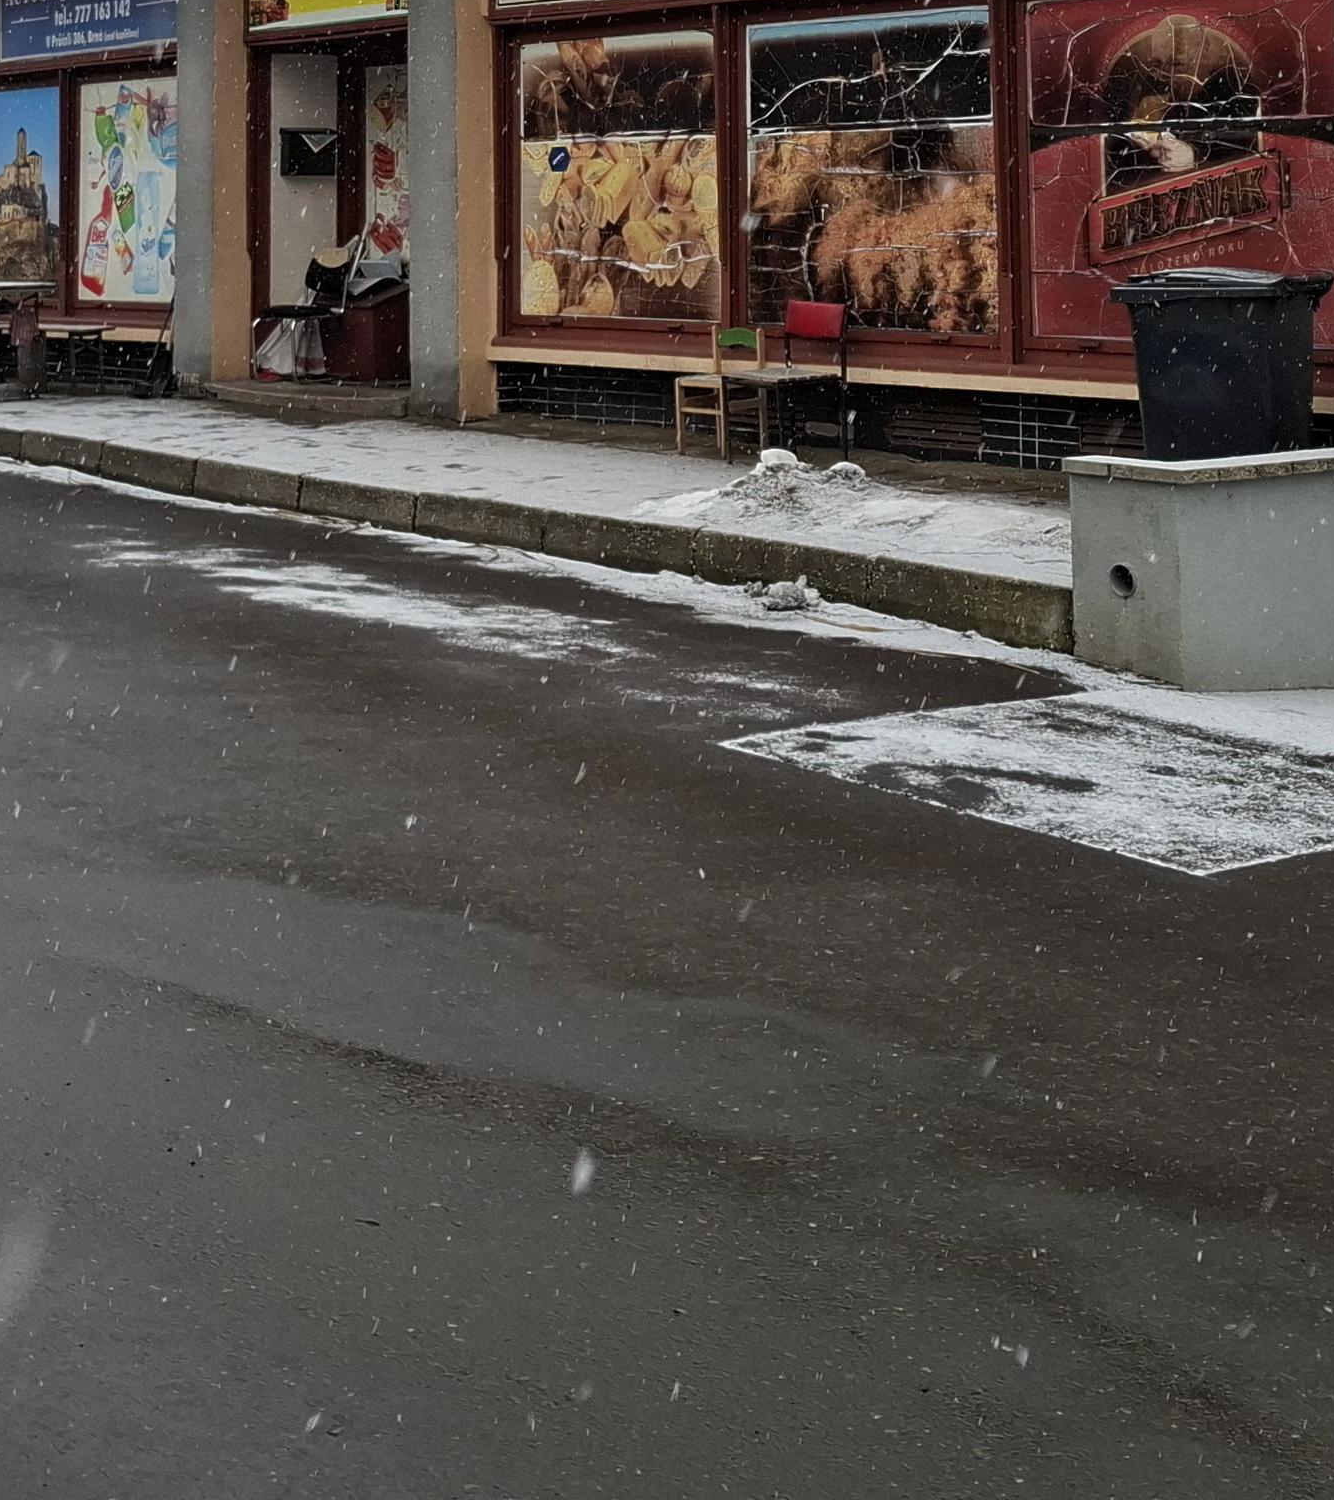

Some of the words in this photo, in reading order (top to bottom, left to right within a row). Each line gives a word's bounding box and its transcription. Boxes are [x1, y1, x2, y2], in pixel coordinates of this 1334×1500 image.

[75, 4, 92, 23] 777
[94, 1, 111, 21] 163
[1209, 240, 1244, 258] ROKU
